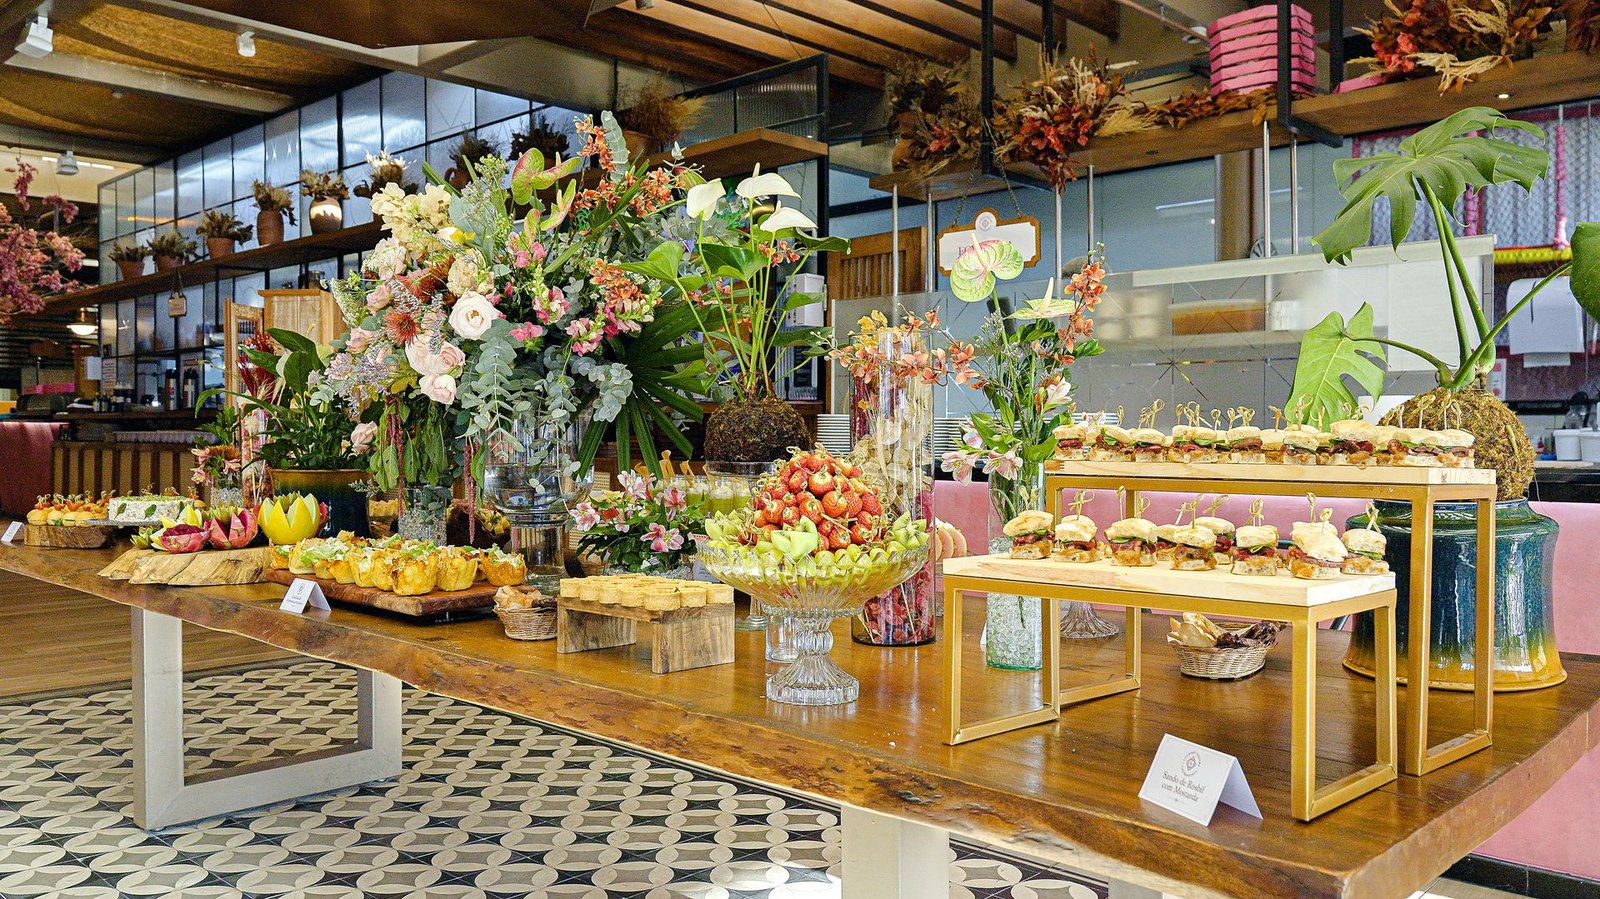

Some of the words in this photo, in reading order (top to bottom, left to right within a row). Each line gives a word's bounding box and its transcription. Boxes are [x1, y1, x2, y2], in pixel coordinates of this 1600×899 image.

[1162, 770, 1179, 784] Sando
[1179, 777, 1187, 787] de
[1161, 782, 1174, 792] com
[1174, 785, 1199, 802] Mostarda
